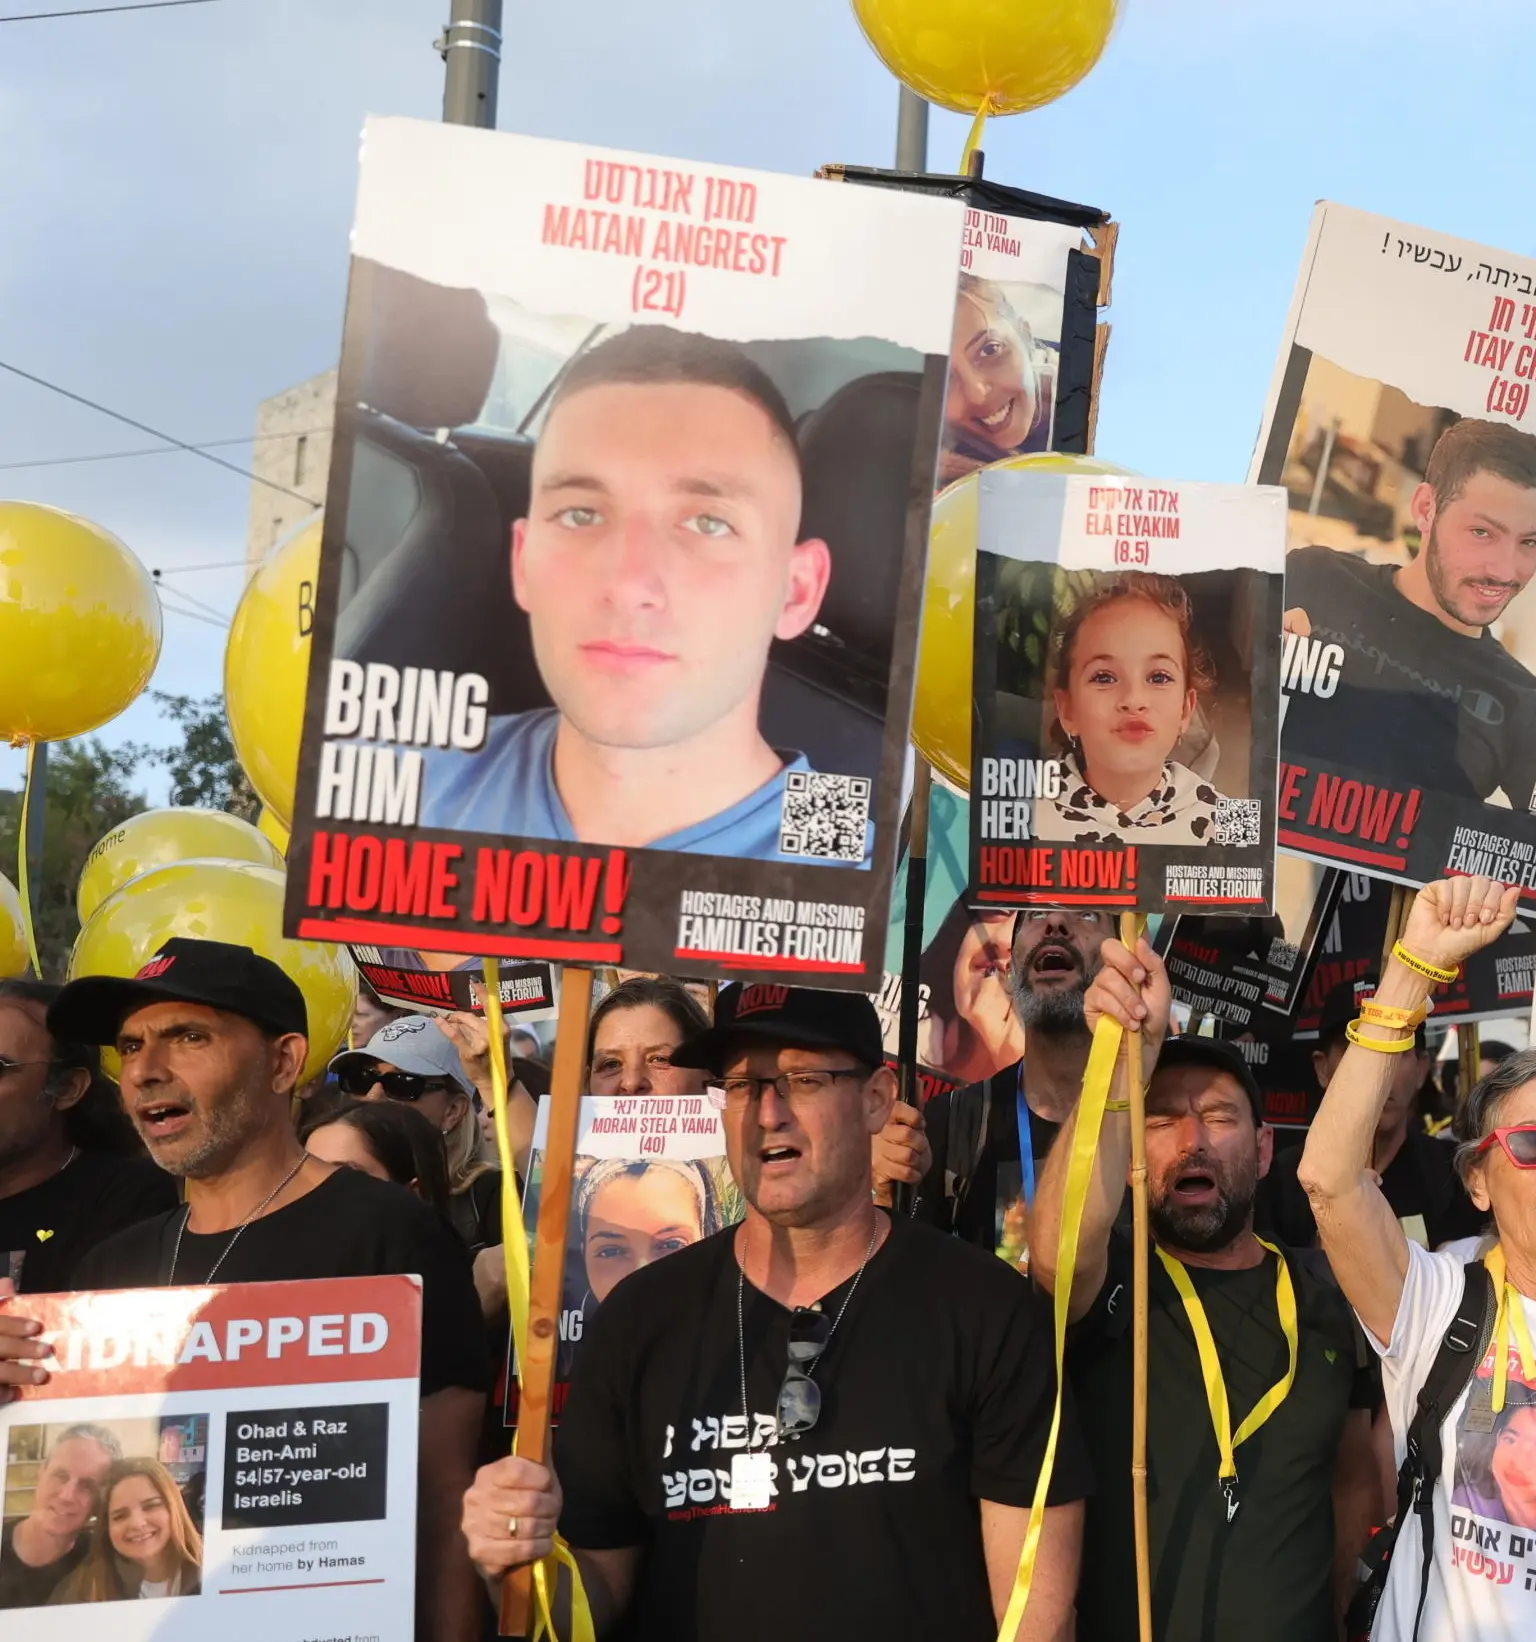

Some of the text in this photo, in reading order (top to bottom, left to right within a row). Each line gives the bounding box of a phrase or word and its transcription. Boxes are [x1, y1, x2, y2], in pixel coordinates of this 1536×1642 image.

[584, 159, 757, 223] מתן אנגרסט
[541, 203, 788, 277] MATAN ANGREST
[987, 233, 1021, 257] YANAI
[632, 264, 687, 319] (21)
[1488, 296, 1517, 332] חן
[1463, 329, 1515, 372] ITAY
[1485, 374, 1531, 421] (19)
[1088, 486, 1179, 513] אלה אליקים
[1085, 512, 1180, 539] ELA ELYAKIM
[1114, 540, 1150, 566] (8.5)
[323, 658, 490, 750] BRING
[315, 741, 423, 826] HIM
[981, 757, 1062, 800] BRING
[980, 800, 1032, 841] HER
[1307, 771, 1421, 849] NOW!
[1453, 826, 1534, 862] HOSTAGES AND
[307, 831, 634, 935] HOME NOW!
[979, 846, 1138, 890] HOME NOW!
[1165, 864, 1264, 882] HOSTAGES AND MISSING
[1446, 843, 1521, 885] FAMILIES
[1165, 878, 1263, 899] FAMILIES FORUM
[680, 890, 866, 930] HOSTAGES AND MISSING
[677, 916, 864, 965] FAMILIES FORUM
[591, 1117, 718, 1135] MORAN STELA YANAI
[613, 1098, 702, 1117] מורן סטלה ינאי
[639, 1135, 666, 1155] (40)
[237, 1419, 348, 1441] Ohad & Raz
[663, 1412, 779, 1458] I HEA
[237, 1443, 317, 1463] Ben-Ami
[787, 1446, 916, 1492] VOICE
[235, 1462, 367, 1488] 54|57-year-old
[234, 1490, 303, 1509] Israelis
[232, 1537, 338, 1560] Kidnapped from
[1451, 1514, 1502, 1553] אותם
[231, 1554, 366, 1576] her home by Hamas
